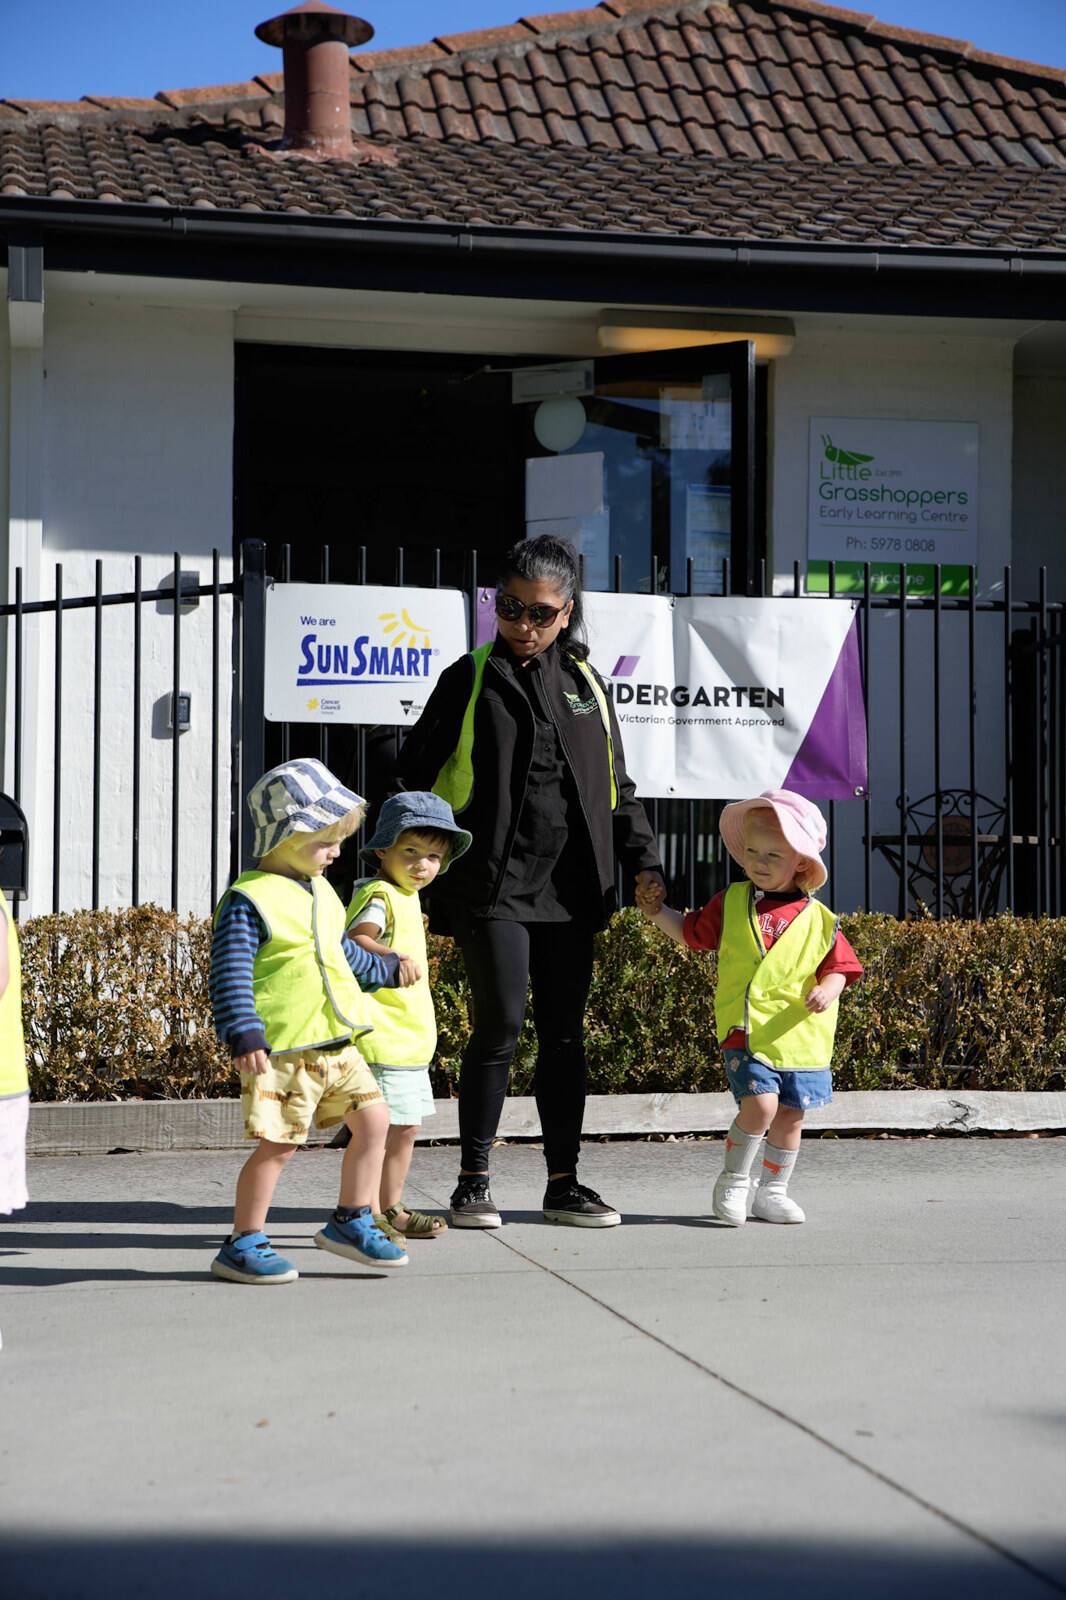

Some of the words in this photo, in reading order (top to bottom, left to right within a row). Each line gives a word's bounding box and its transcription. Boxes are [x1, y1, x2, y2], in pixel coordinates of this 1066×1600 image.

[819, 461, 872, 481] Little
[818, 481, 969, 509] Grasshoppers
[819, 505, 854, 521] Early
[856, 507, 917, 524] Learning
[921, 509, 968, 523] Centre
[845, 536, 867, 550] Ph:
[871, 537, 902, 551] 5978
[905, 538, 936, 552] 0808
[300, 615, 317, 626] We
[319, 618, 336, 626] are
[618, 714, 665, 724] Victorian
[668, 716, 732, 726] Government
[735, 717, 784, 728] Approved
